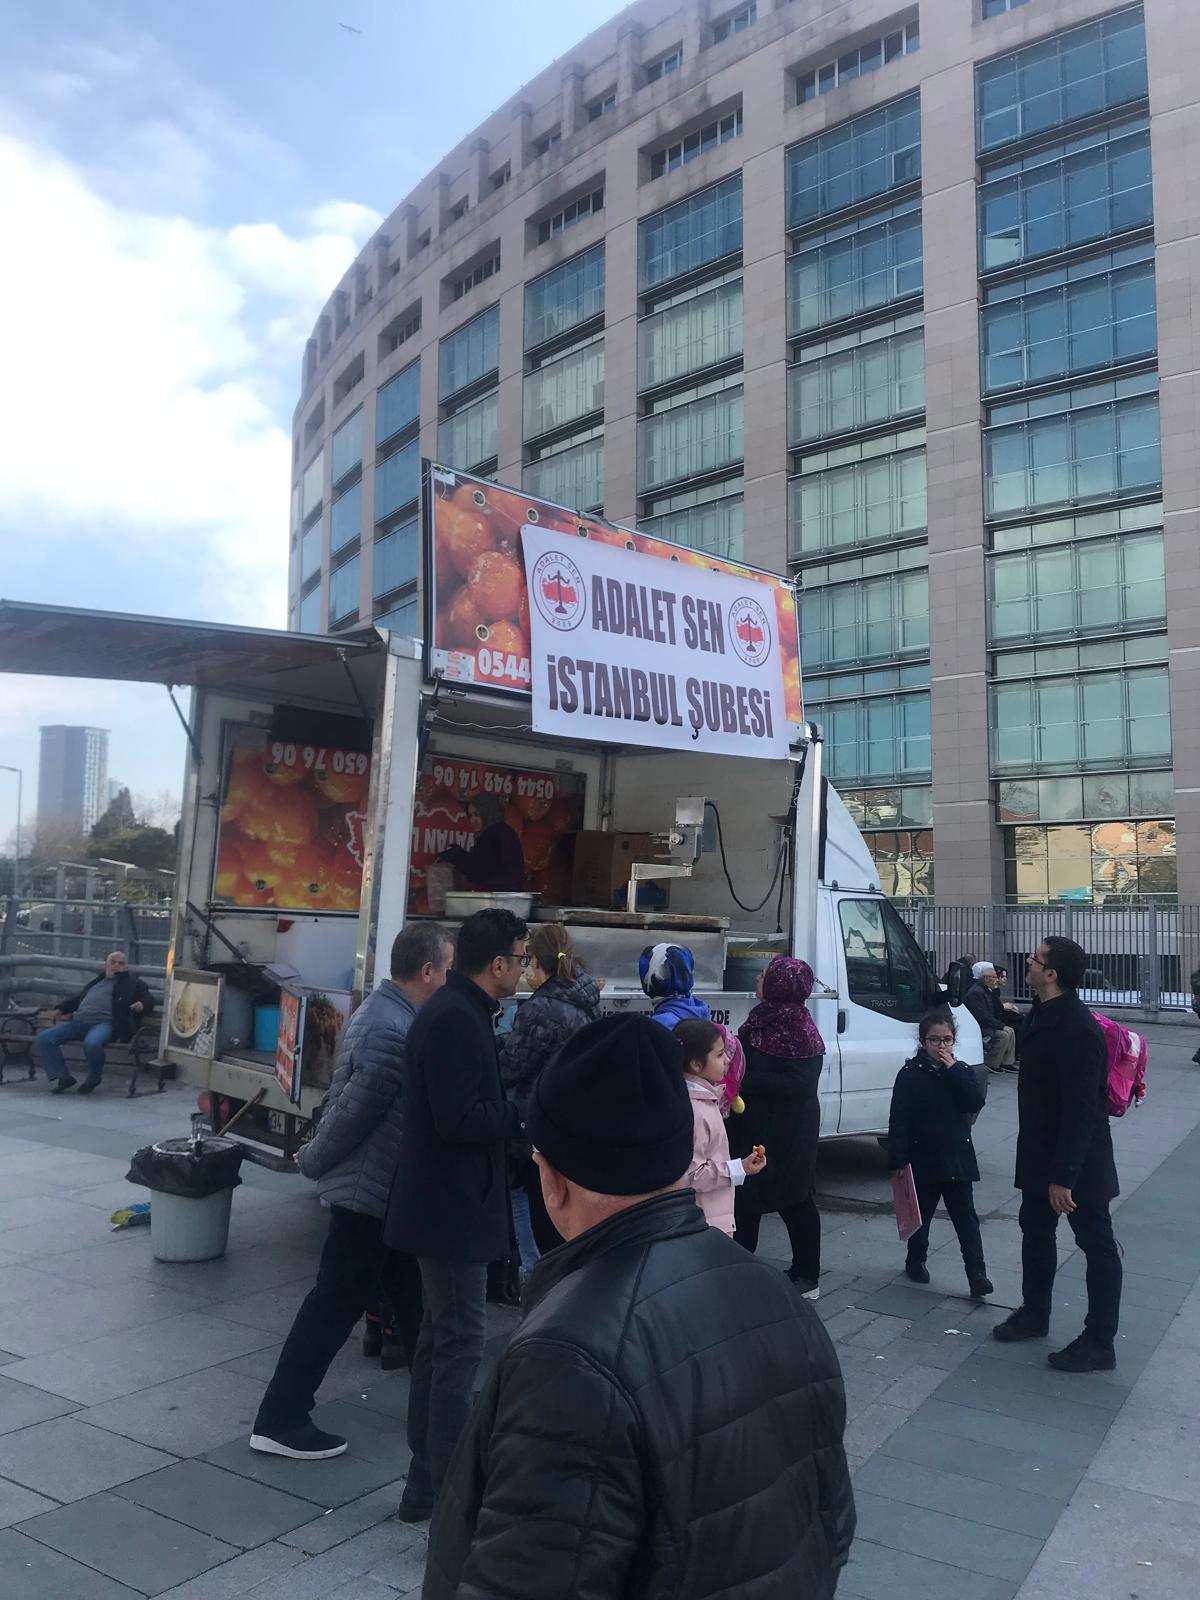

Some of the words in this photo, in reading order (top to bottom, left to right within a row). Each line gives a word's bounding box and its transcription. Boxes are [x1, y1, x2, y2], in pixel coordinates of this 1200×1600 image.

[537, 554, 564, 574] ADALET
[591, 574, 676, 645] ADALET
[681, 595, 725, 655] SEN
[478, 648, 532, 683] 0544
[271, 742, 297, 764] 06
[304, 746, 327, 769] 76
[333, 750, 368, 775] 650
[433, 765, 455, 787] 06
[459, 769, 479, 789] 14
[484, 772, 513, 794] 942
[517, 776, 554, 799] 0544
[271, 1112, 282, 1131] 34
